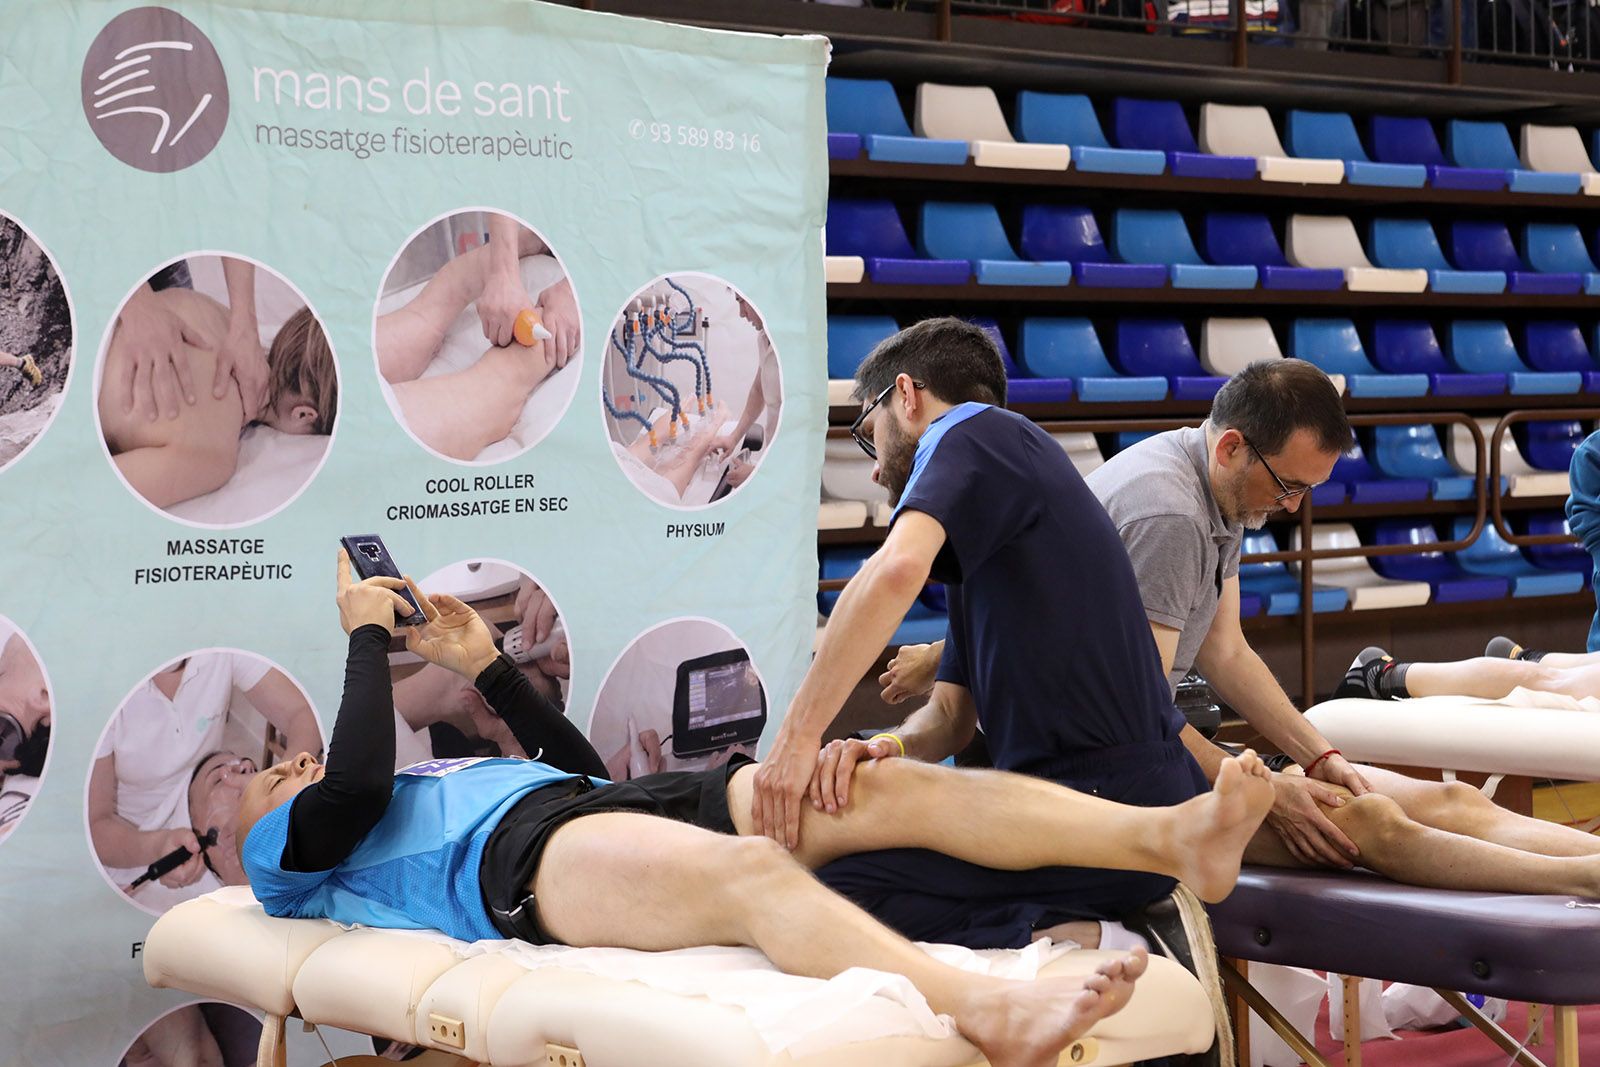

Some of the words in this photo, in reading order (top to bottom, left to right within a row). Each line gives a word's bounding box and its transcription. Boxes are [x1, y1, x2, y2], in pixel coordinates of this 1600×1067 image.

[253, 66, 391, 113] mans
[402, 66, 462, 116] de
[474, 80, 572, 123] sant
[256, 123, 386, 160] massatge
[392, 126, 573, 162] fisioterapèutic
[650, 122, 671, 143] 93
[678, 126, 708, 147] 589
[714, 130, 735, 151] 83
[742, 133, 760, 152] 16
[426, 478, 470, 494] COOL
[474, 474, 534, 491] ROLLER
[387, 500, 510, 521] CRIOMASSATGE
[515, 498, 535, 513] EN
[539, 497, 568, 512] SEC
[666, 522, 725, 538] PHYSIUM
[167, 539, 264, 556] MASSATGE
[135, 561, 293, 585] FISIOTERAPÈUTIC
